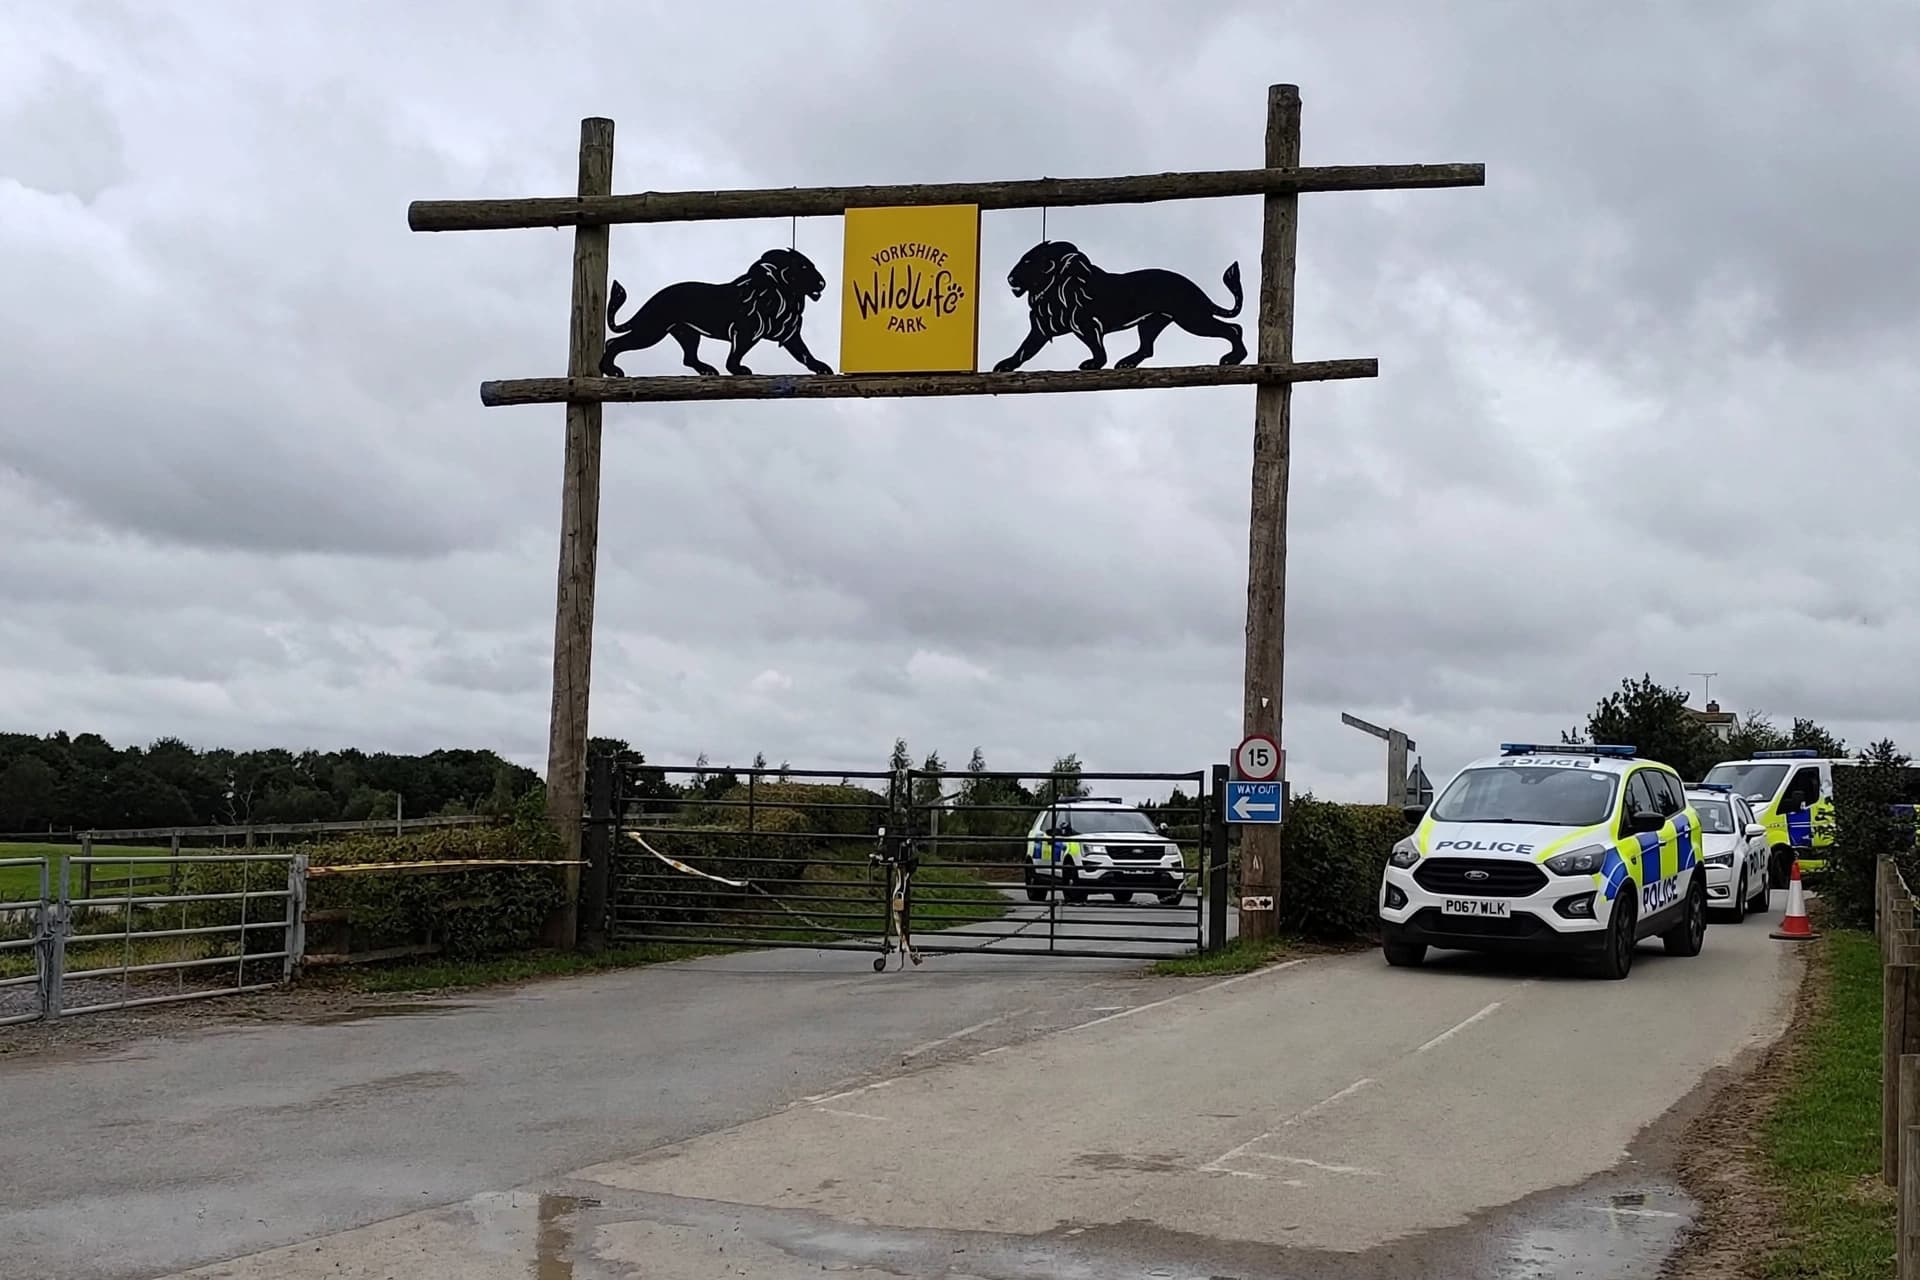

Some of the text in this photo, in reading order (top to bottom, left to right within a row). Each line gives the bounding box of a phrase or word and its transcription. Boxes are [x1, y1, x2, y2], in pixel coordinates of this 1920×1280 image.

[872, 243, 948, 267] YORKSHIRE
[887, 316, 927, 333] PARK
[1249, 749, 1268, 767] 15
[1238, 785, 1275, 794] WAY OUT
[1436, 840, 1535, 854] POLICE
[1749, 847, 1766, 876] POCE
[1643, 874, 1678, 913] POLICE
[1446, 900, 1505, 915] PO67 WLK
